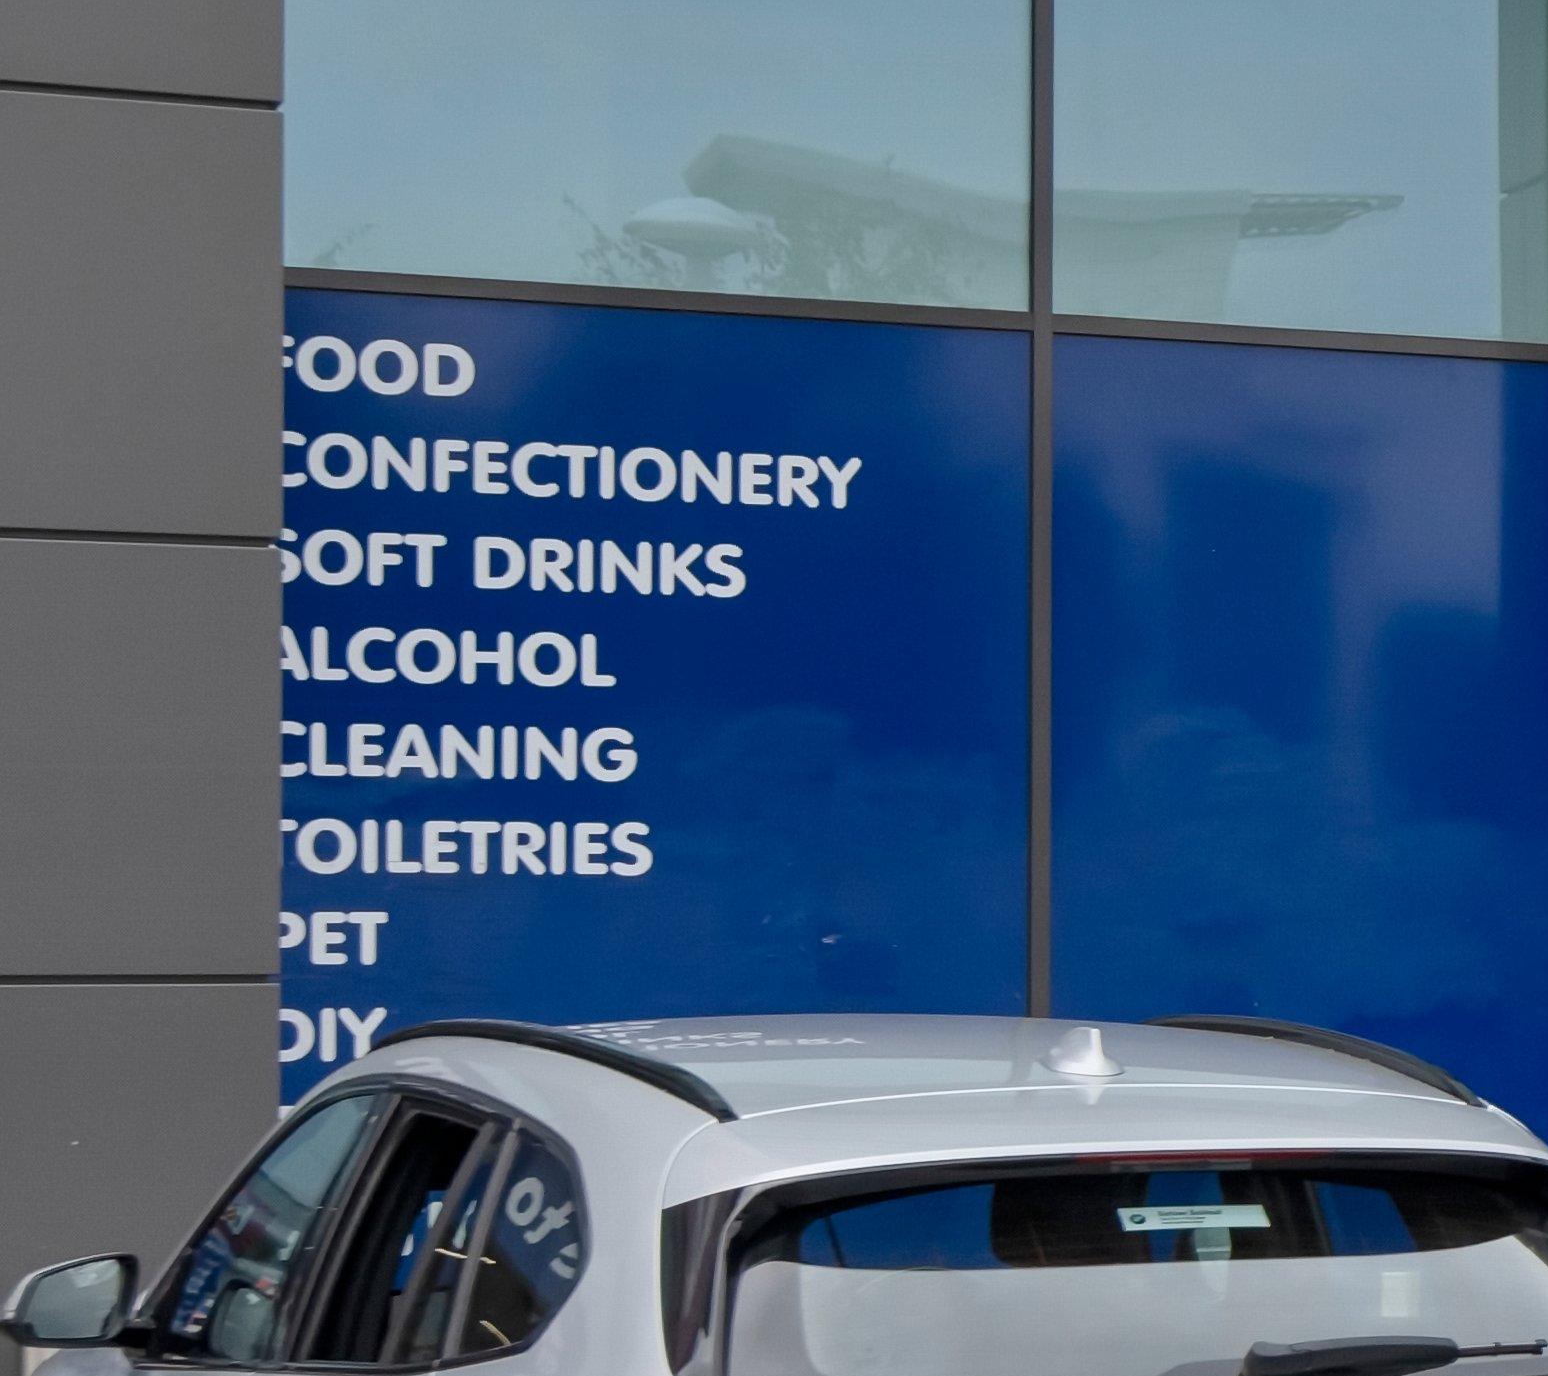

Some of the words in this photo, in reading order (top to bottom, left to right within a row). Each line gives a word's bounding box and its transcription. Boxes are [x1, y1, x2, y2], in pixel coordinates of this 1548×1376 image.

[282, 334, 477, 397] OOD
[474, 537, 747, 599] DRINKS
[281, 625, 618, 688] ALCOHOL
[280, 817, 654, 878] OILETRIES
[279, 910, 390, 967] PET
[279, 1007, 387, 1063] DIY
